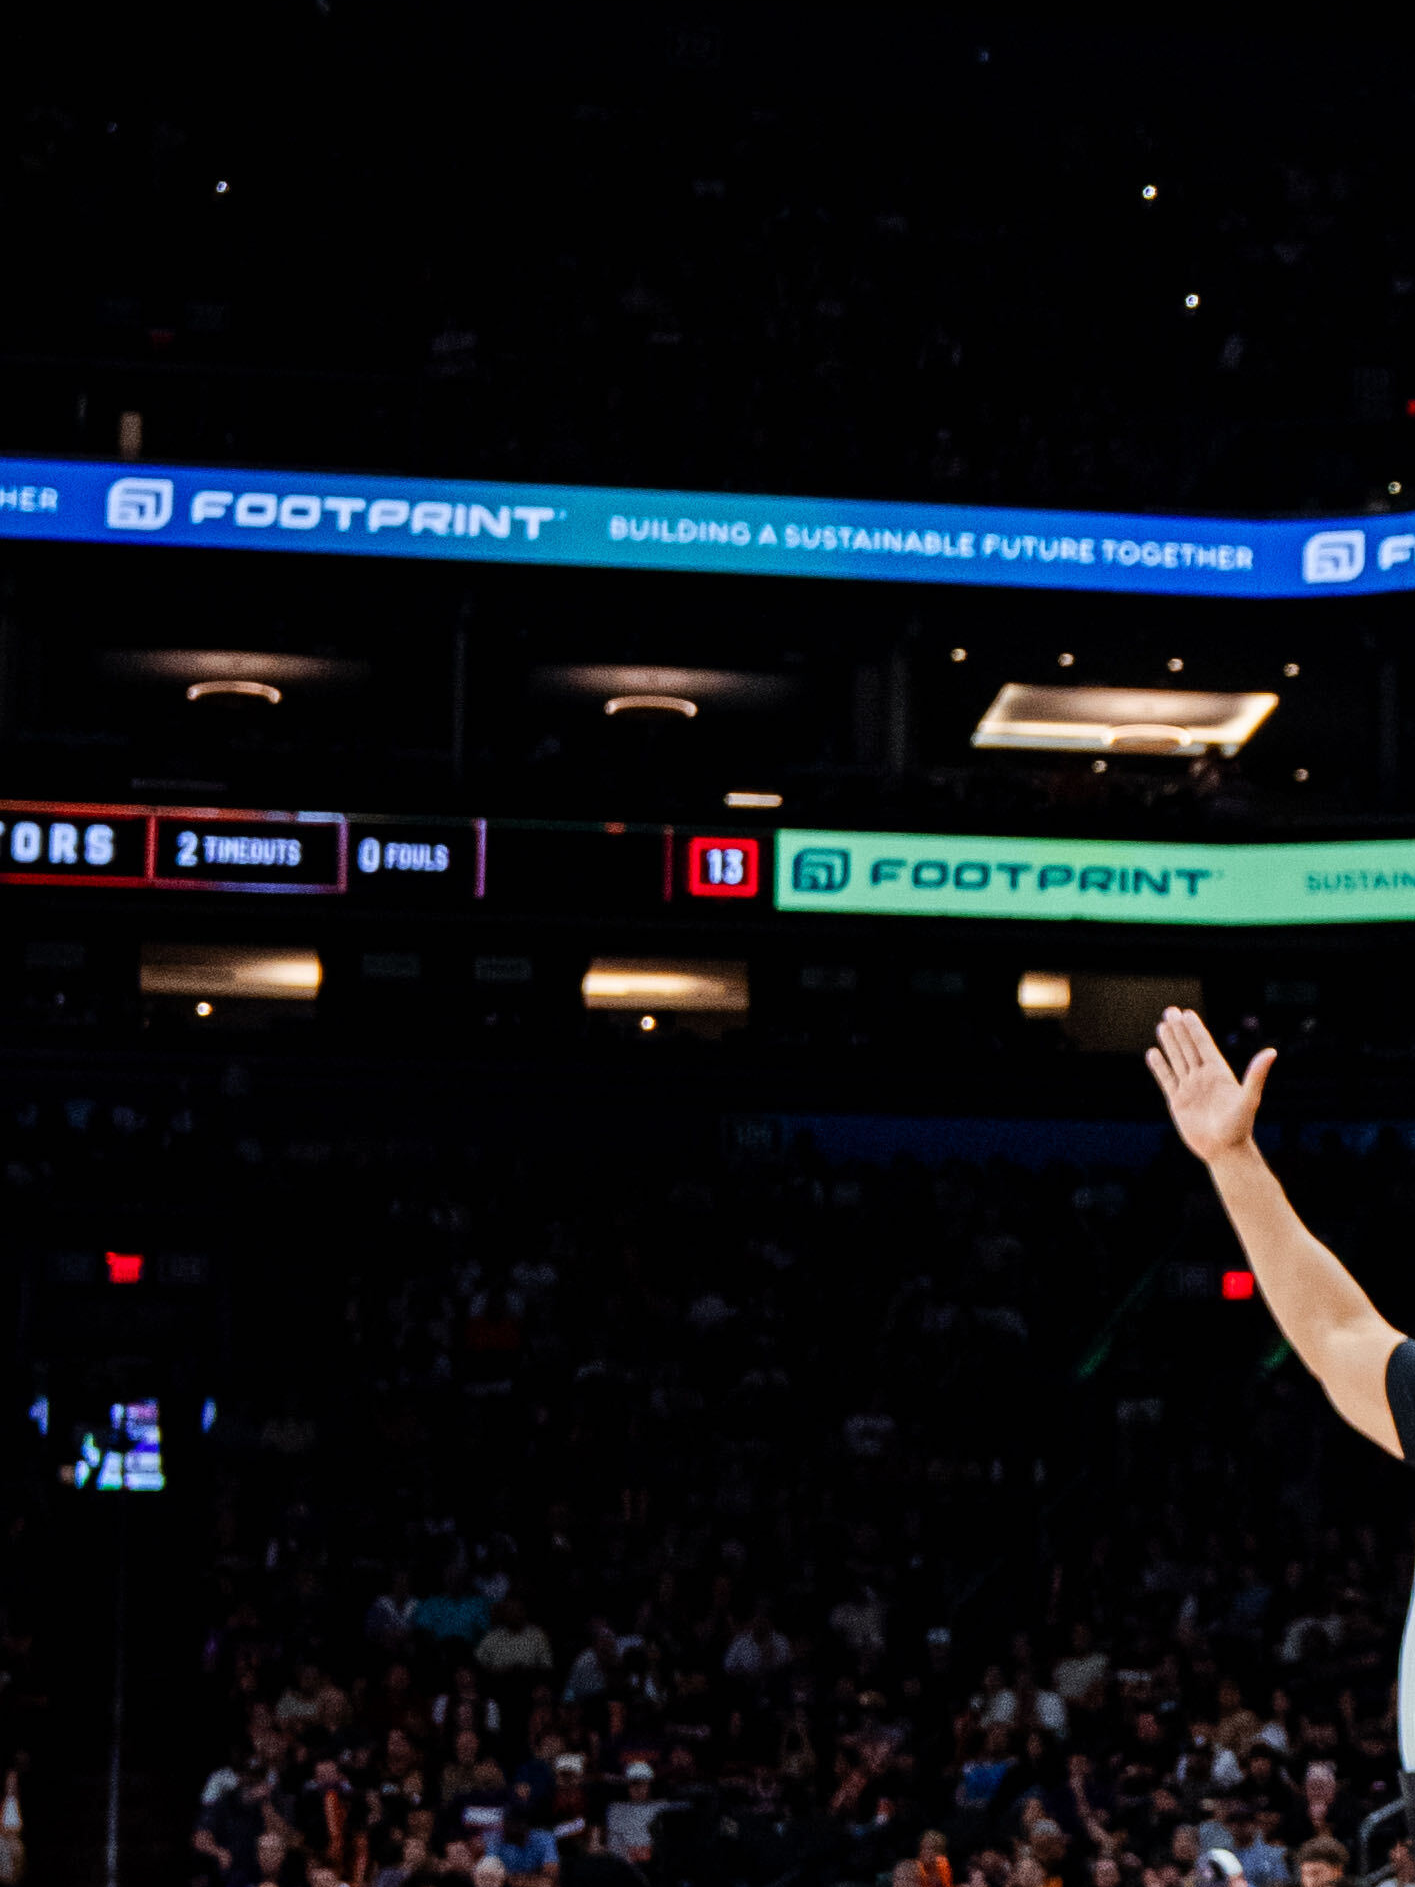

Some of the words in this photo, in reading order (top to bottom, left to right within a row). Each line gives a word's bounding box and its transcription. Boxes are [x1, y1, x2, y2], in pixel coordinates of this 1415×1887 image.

[191, 489, 556, 541] FOOTPRINT
[609, 515, 750, 546] BUILDING
[758, 523, 778, 545] A
[784, 523, 976, 558] SUSTAINABLE
[981, 533, 1095, 564] FUTURE
[1101, 539, 1254, 571] TOGETHER
[176, 830, 198, 867] 2
[203, 835, 302, 867] TIMEOUTS
[384, 842, 449, 873] FOULS
[870, 858, 1210, 897] FOOTPRINT
